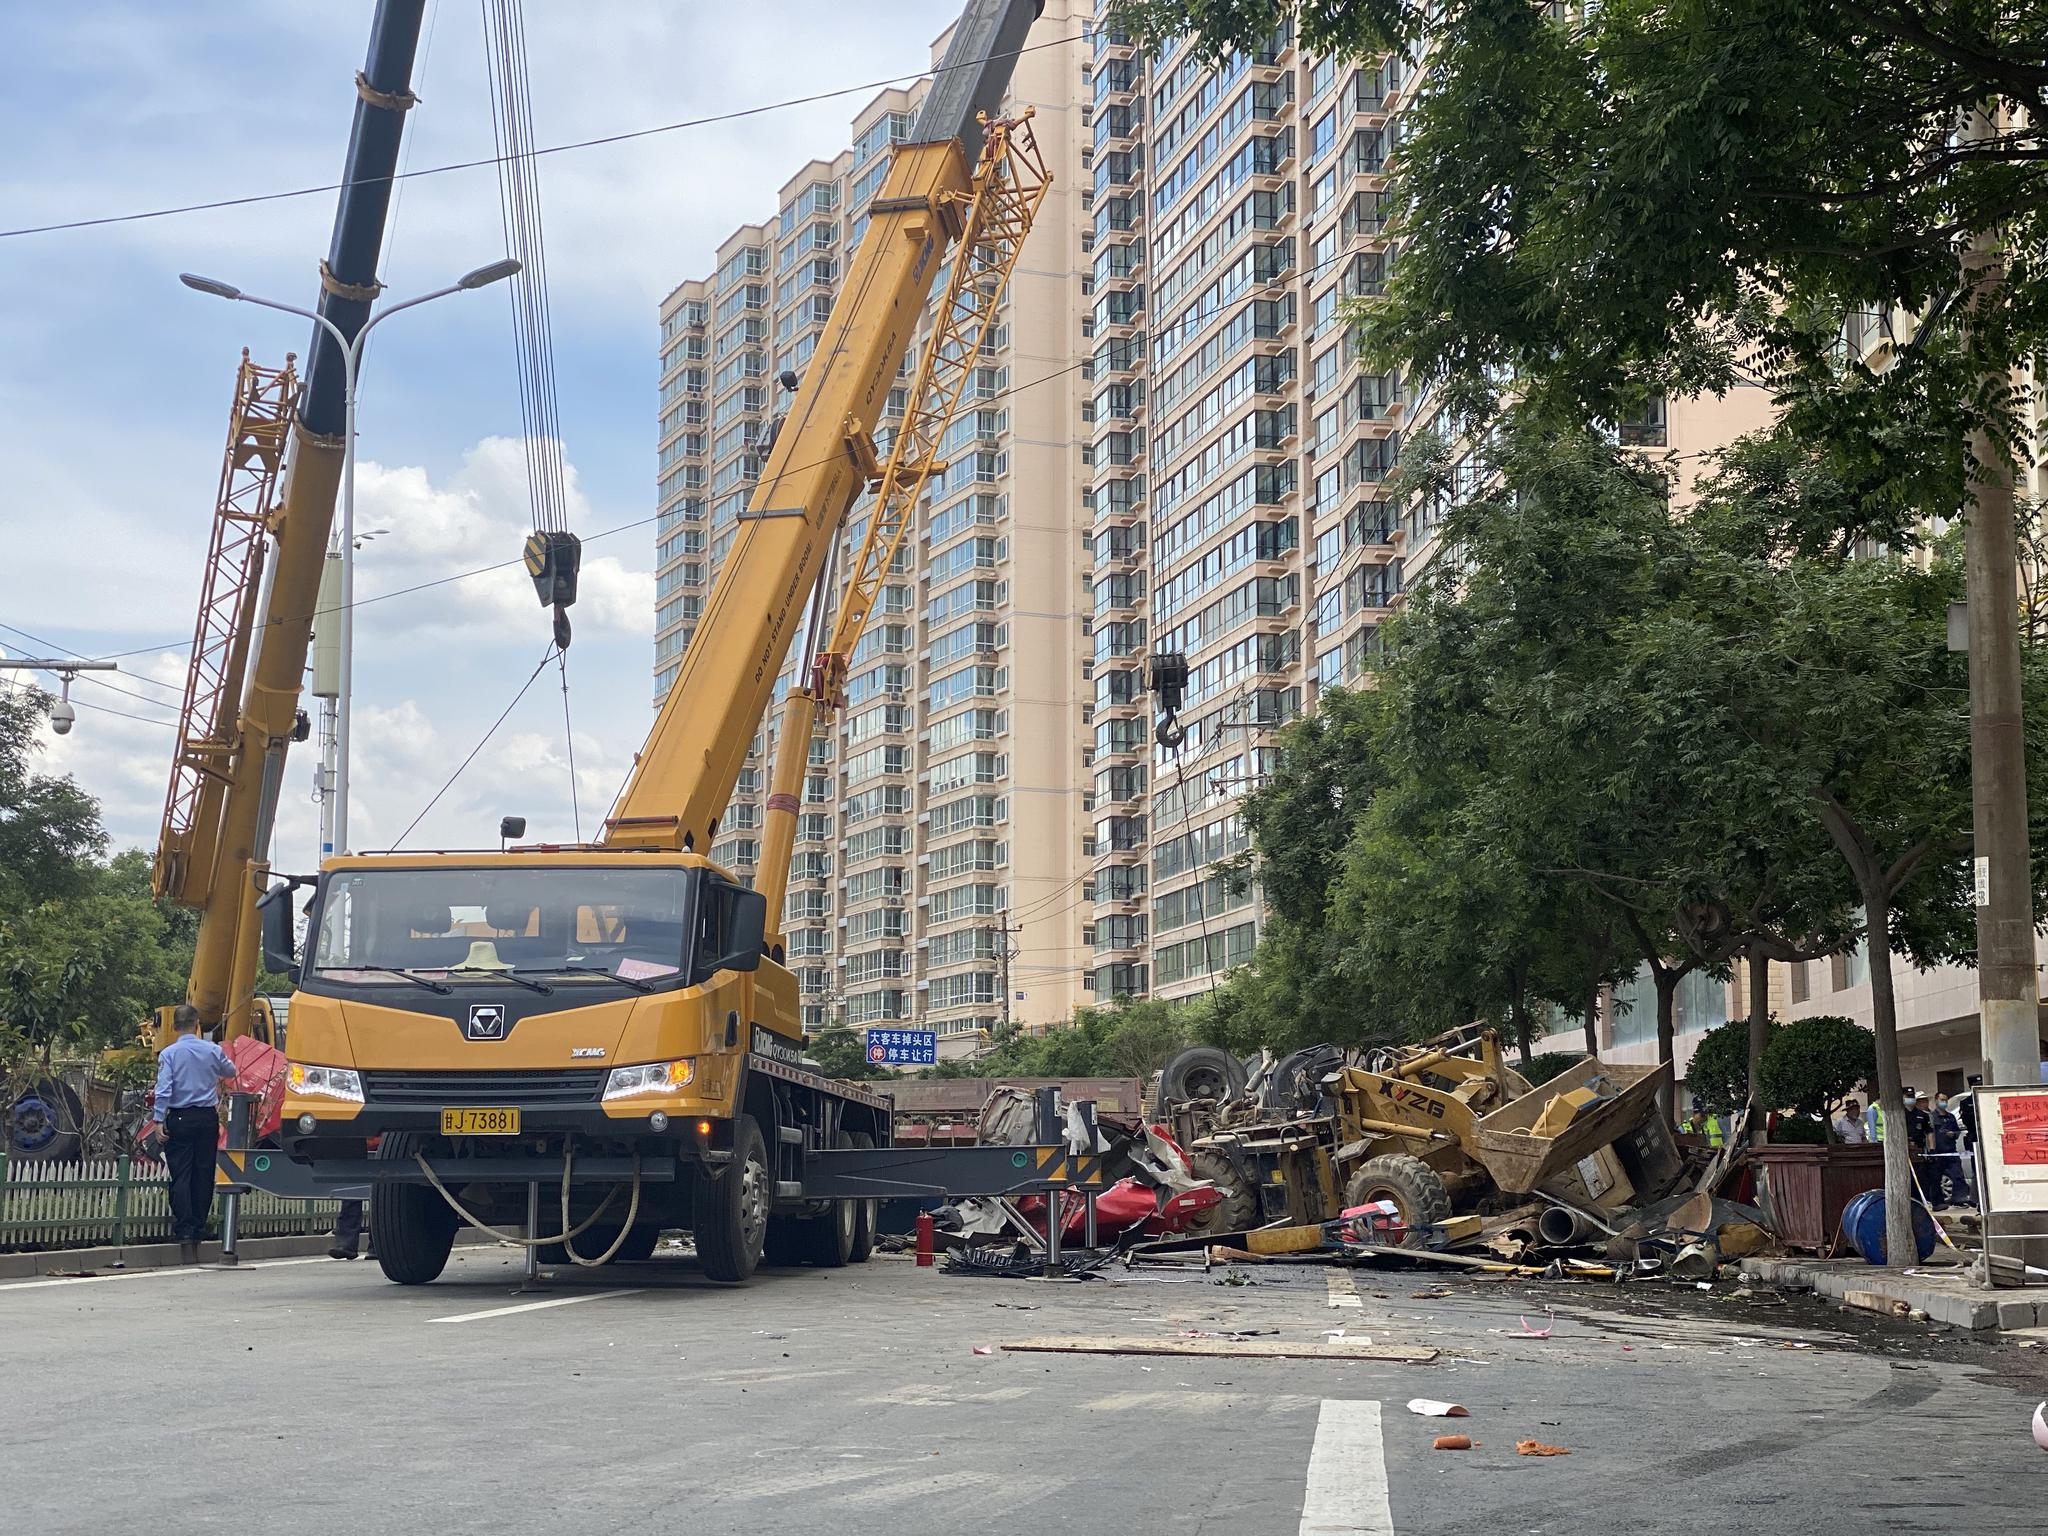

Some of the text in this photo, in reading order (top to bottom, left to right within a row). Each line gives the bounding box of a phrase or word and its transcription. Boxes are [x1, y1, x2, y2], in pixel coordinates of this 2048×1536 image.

[754, 540, 812, 683] DO NOT STAND UNDER BOOM!
[870, 1032, 932, 1046] 大客车掉头区
[571, 1047, 606, 1059] XCMG
[873, 1048, 933, 1062] 停 停车让行
[2022, 1149, 2046, 1161] 入口
